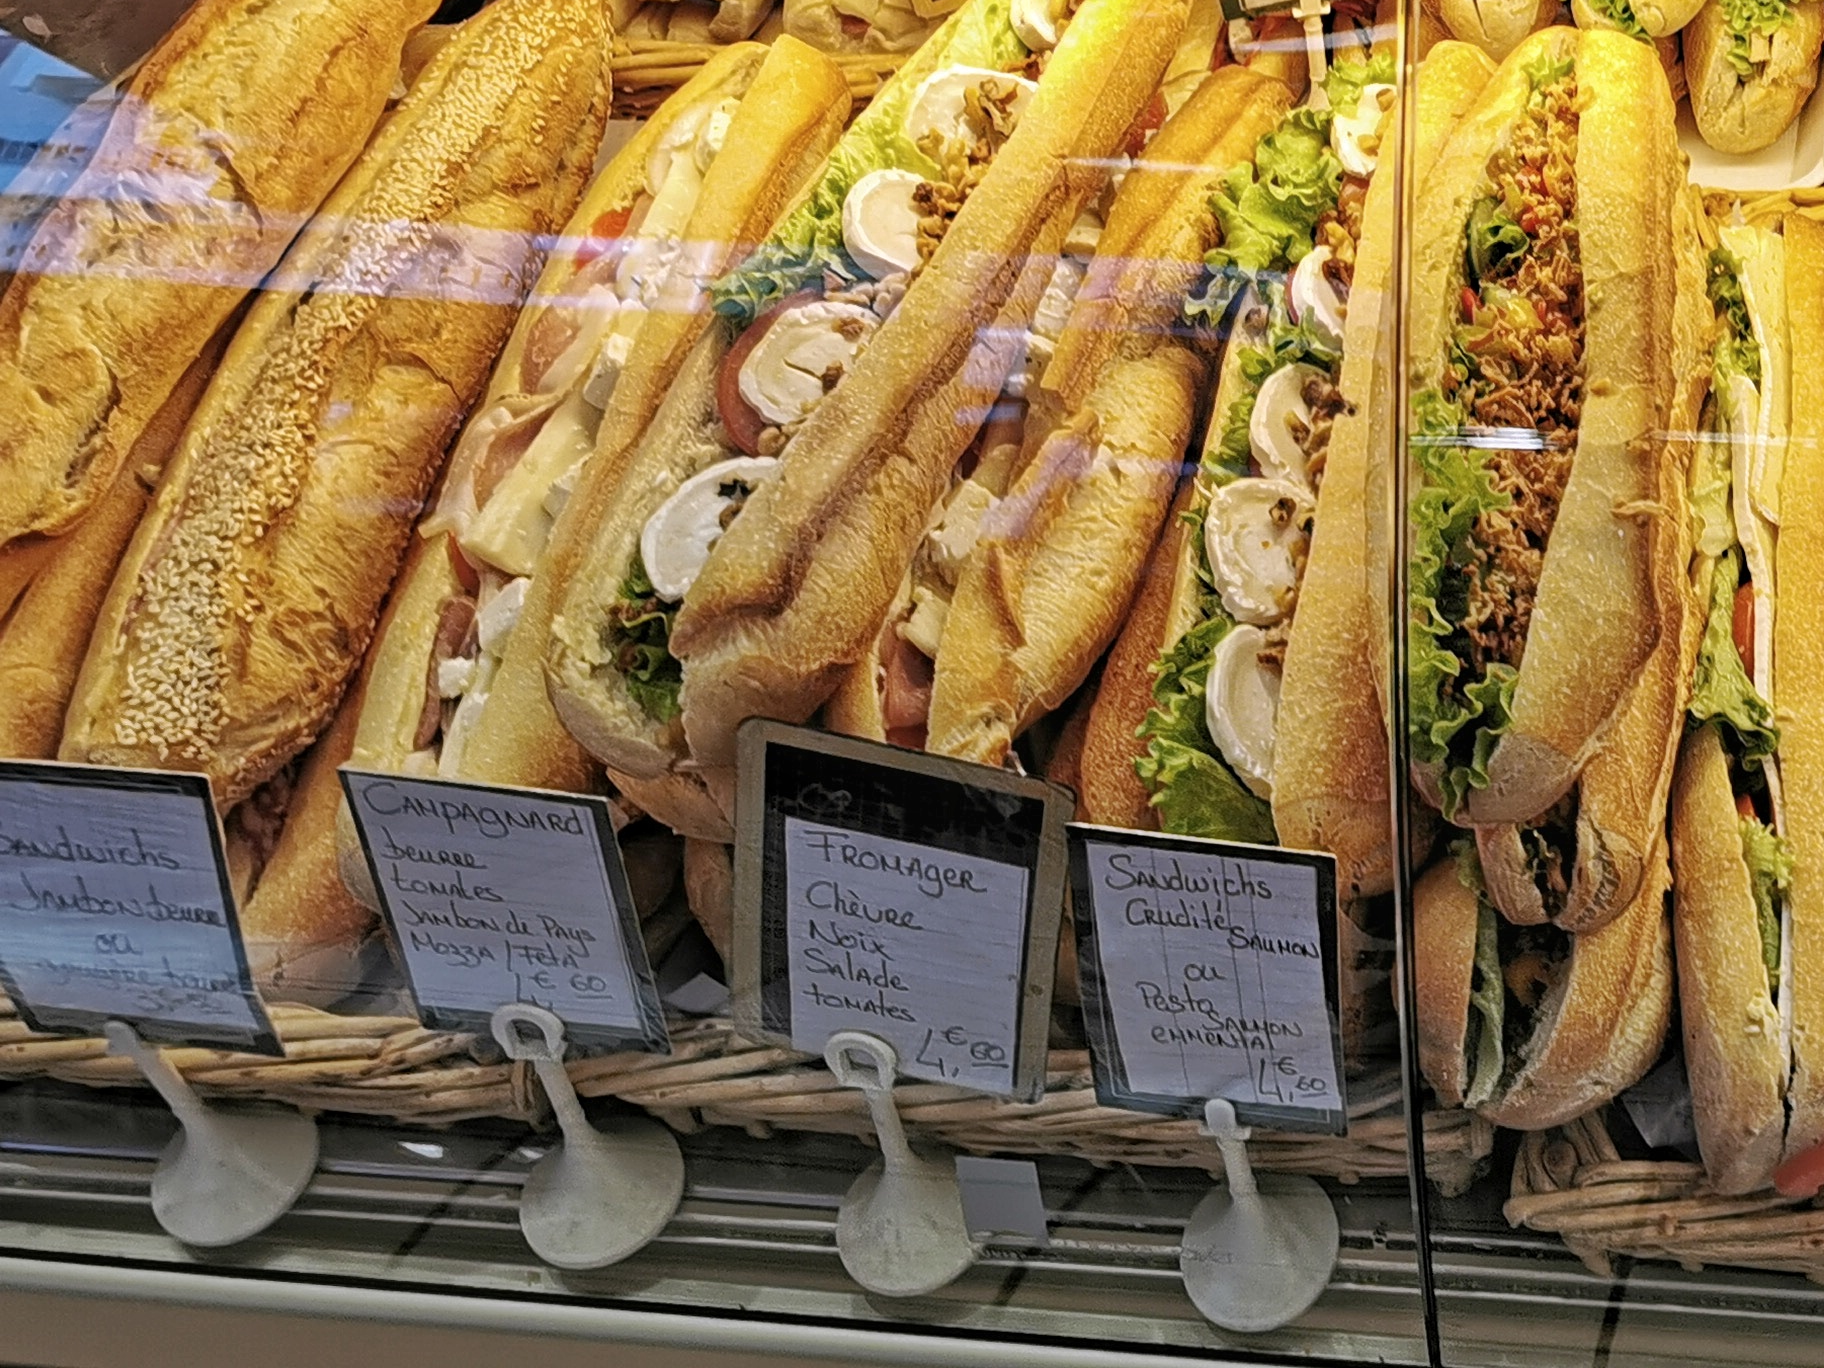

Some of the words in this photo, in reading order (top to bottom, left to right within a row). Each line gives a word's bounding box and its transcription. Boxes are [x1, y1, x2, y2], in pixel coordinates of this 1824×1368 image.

[381, 826, 488, 869] beurre
[506, 909, 531, 936] de
[806, 880, 924, 931] Chèvre
[95, 934, 143, 954] ou
[809, 920, 894, 961] Noix
[804, 948, 910, 992] Salade
[1183, 963, 1226, 982] ou
[1135, 981, 1215, 1015] Pesto
